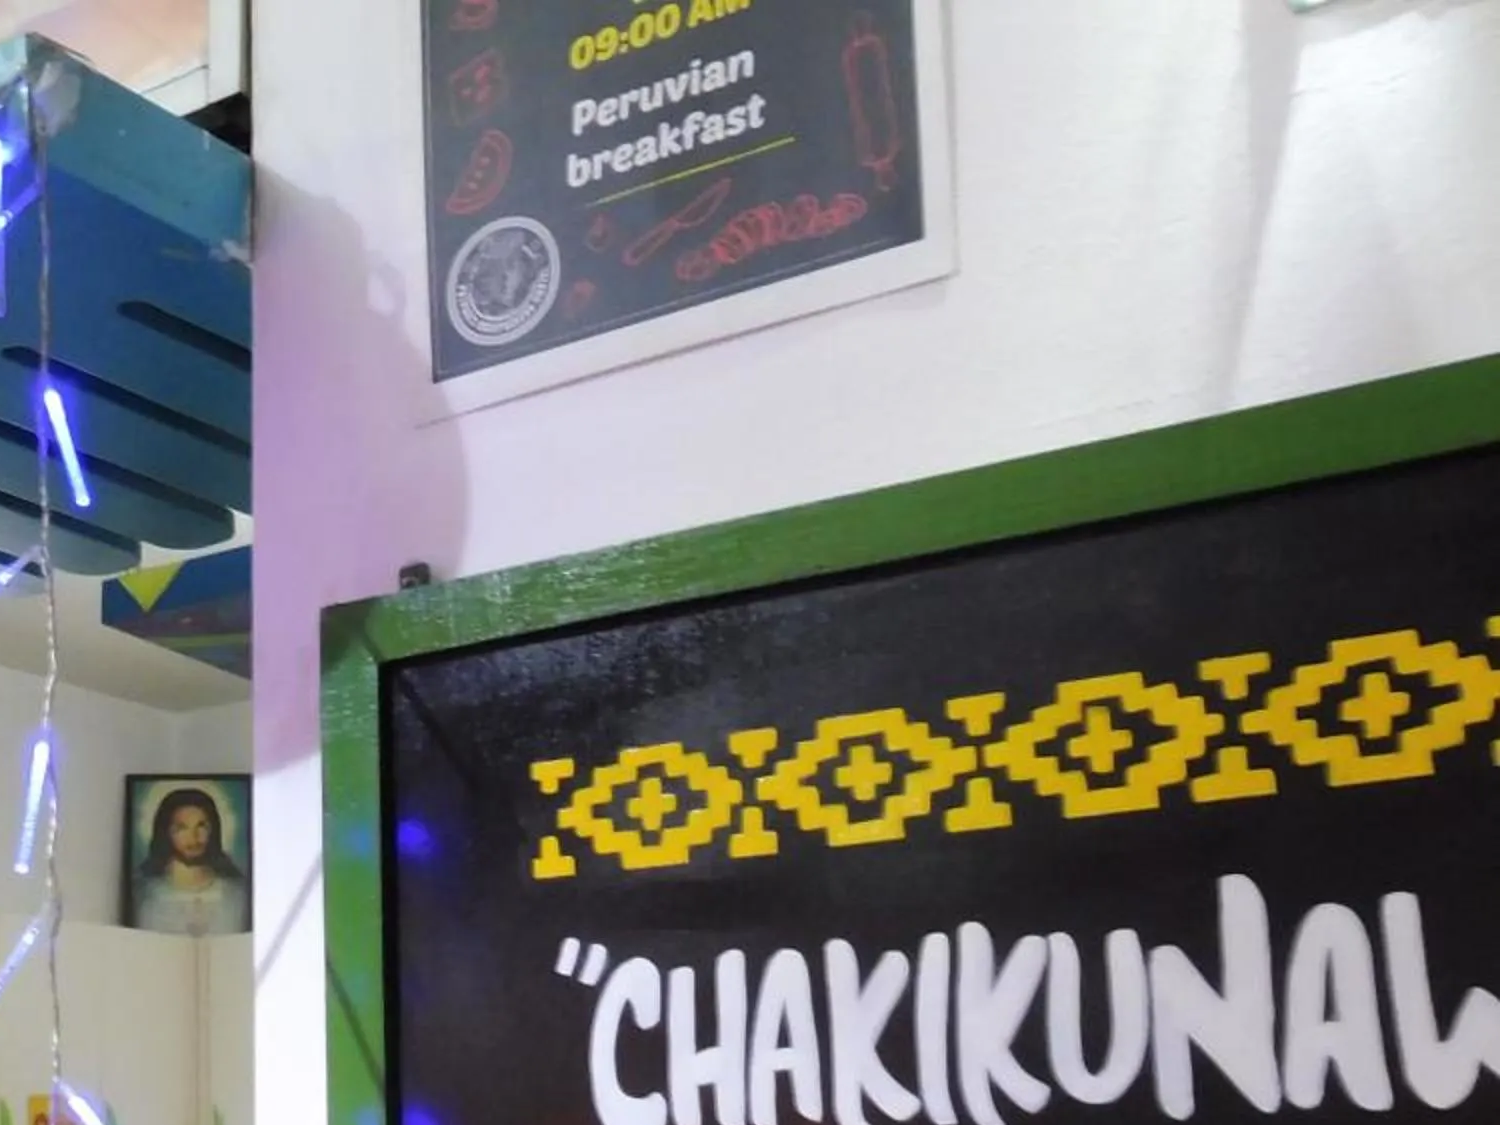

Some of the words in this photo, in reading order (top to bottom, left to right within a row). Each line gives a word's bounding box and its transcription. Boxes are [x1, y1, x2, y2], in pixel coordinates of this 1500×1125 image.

[569, 3, 682, 70] 09:00
[571, 50, 755, 136] Peruvian
[566, 93, 767, 188] breakfast
